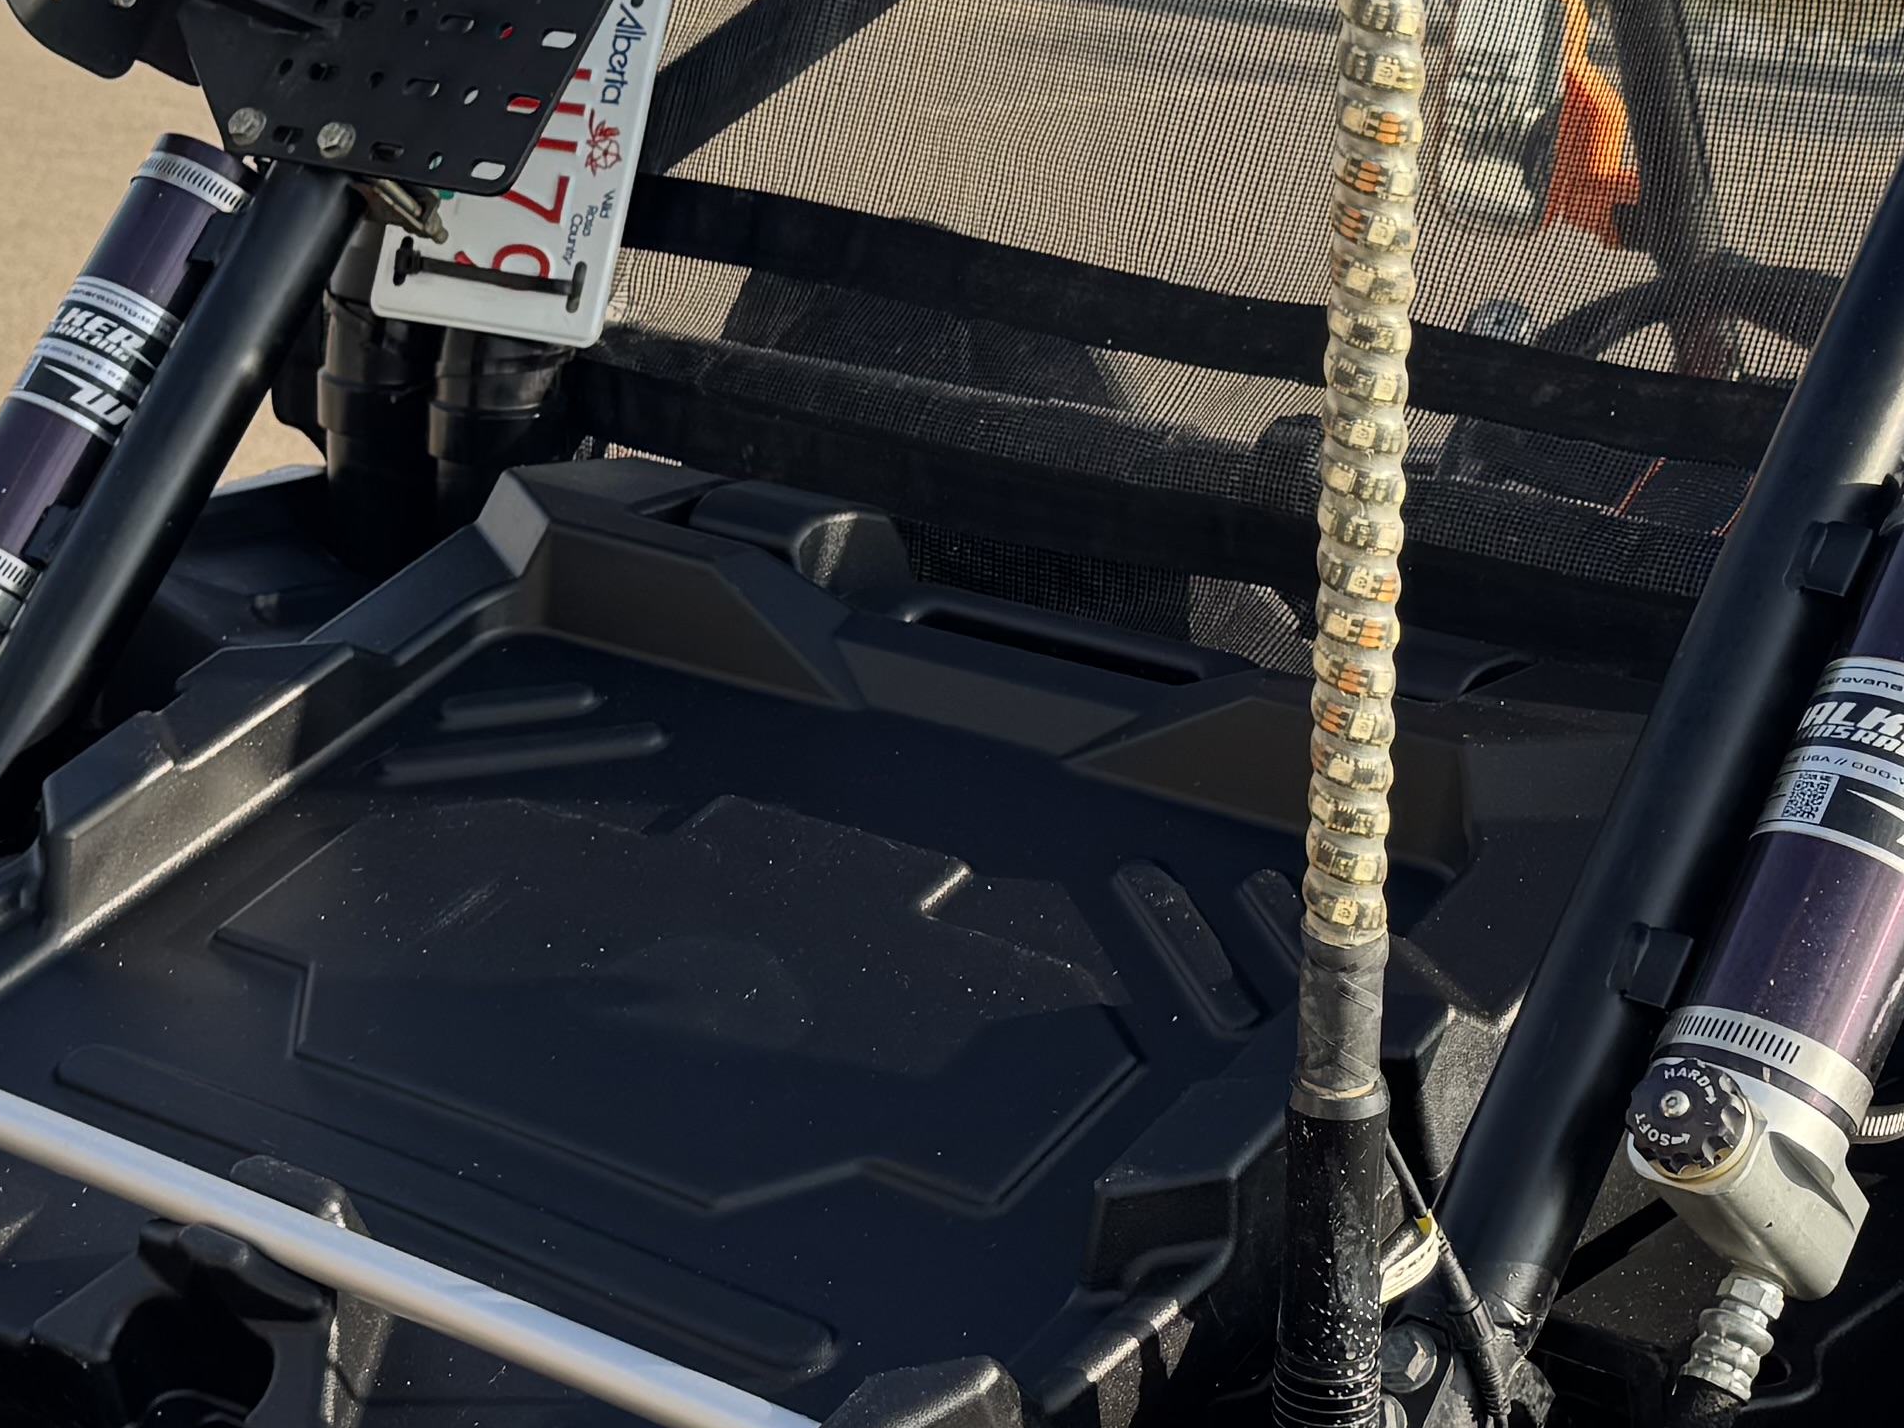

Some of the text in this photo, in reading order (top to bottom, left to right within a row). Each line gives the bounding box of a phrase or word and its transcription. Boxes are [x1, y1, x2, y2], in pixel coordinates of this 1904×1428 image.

[599, 2, 648, 106] Alberta
[1663, 1066, 1711, 1088] HARD
[1634, 1112, 1673, 1147] SOFT
